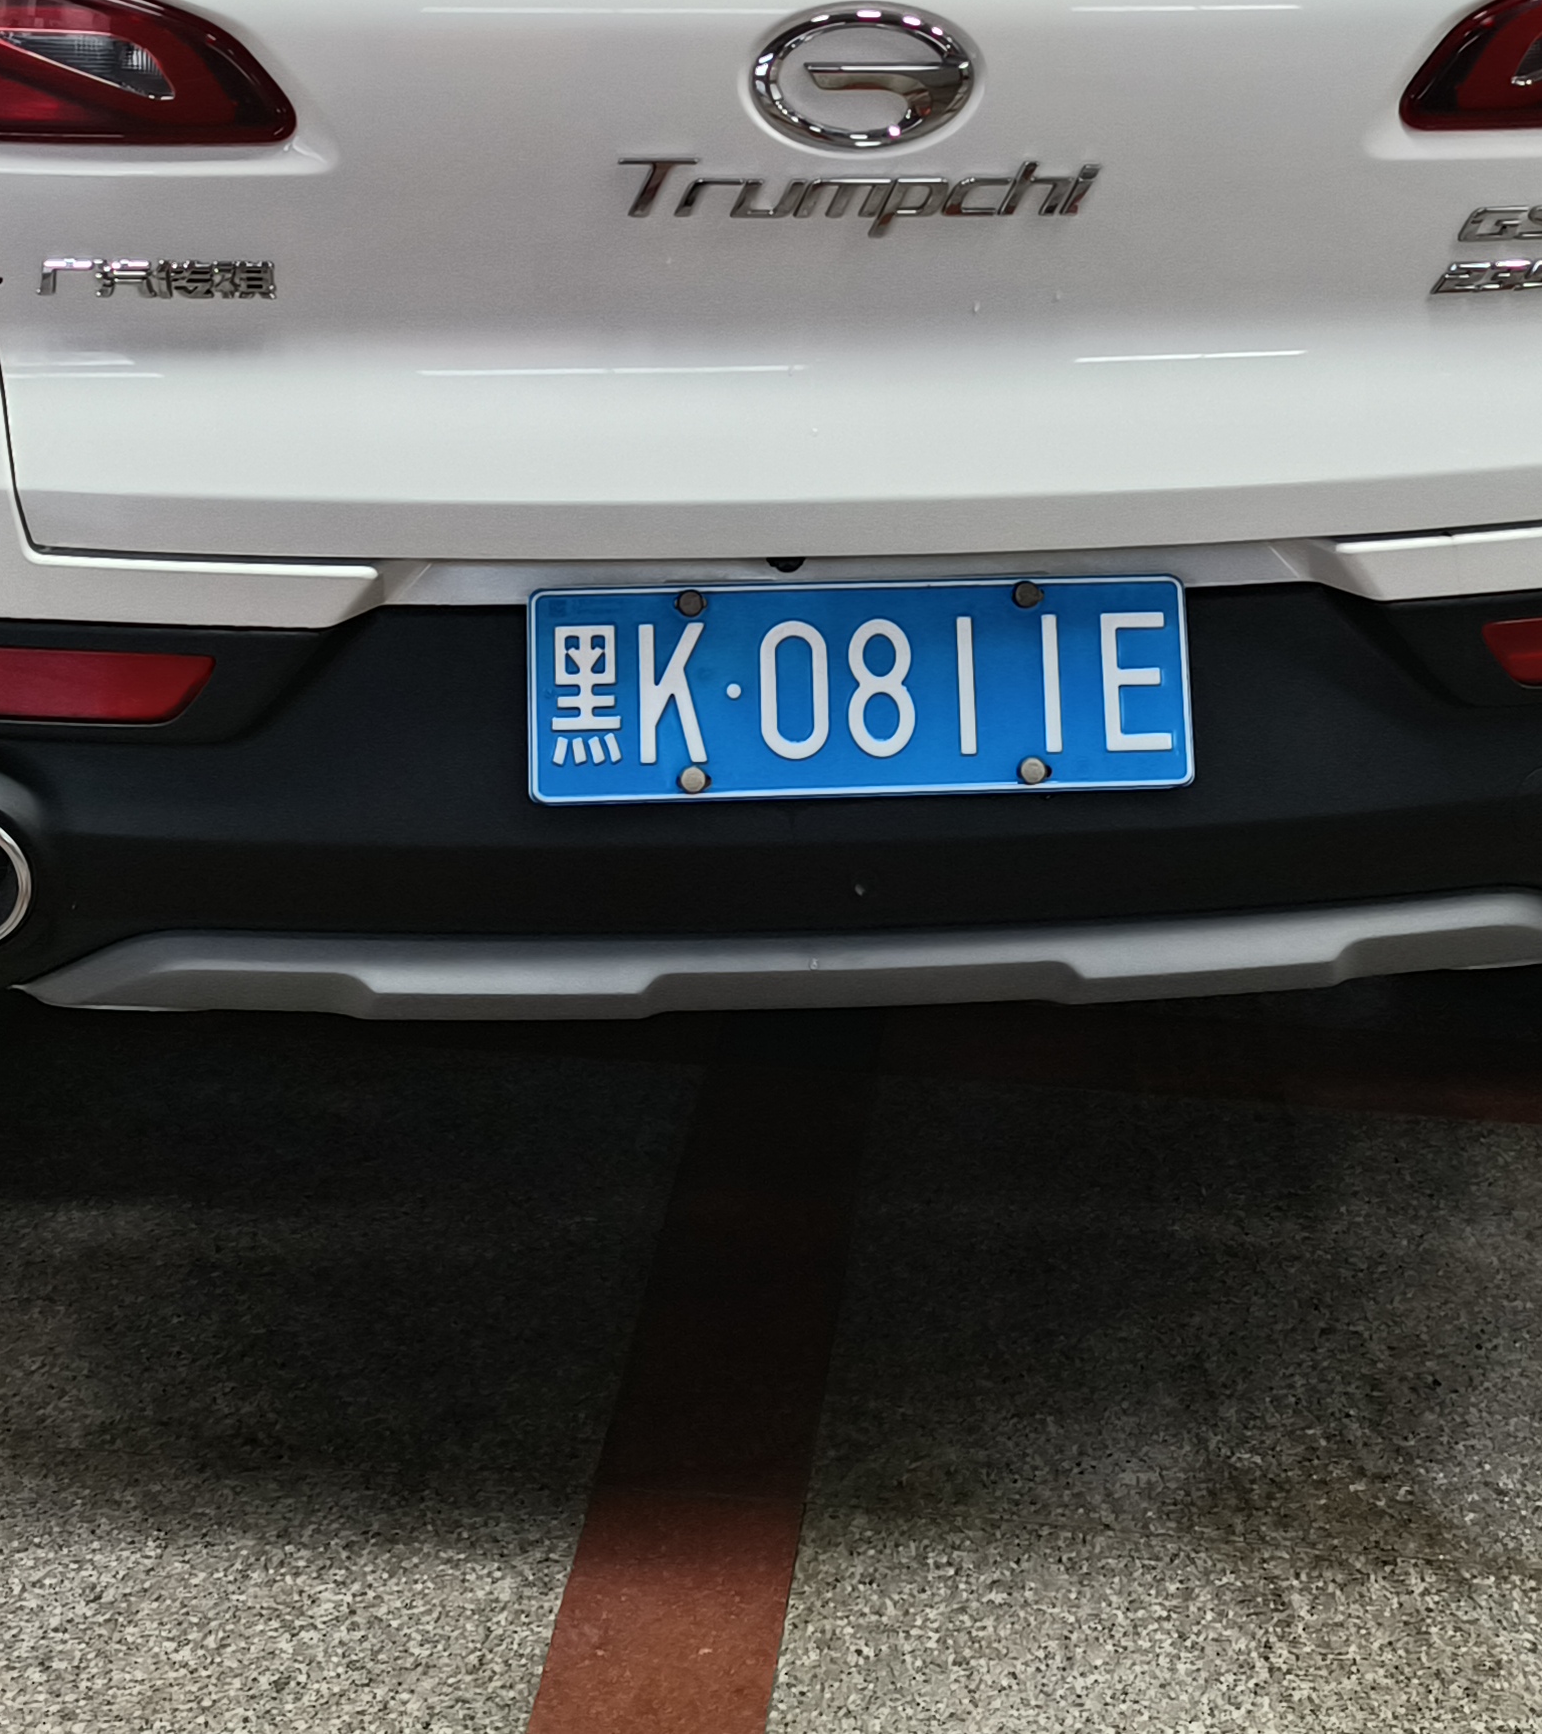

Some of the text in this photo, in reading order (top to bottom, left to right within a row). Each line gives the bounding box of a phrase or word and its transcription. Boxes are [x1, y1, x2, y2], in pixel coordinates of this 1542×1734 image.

[618, 158, 1102, 238] Trumpchi
[36, 257, 277, 299] 广汽传祺
